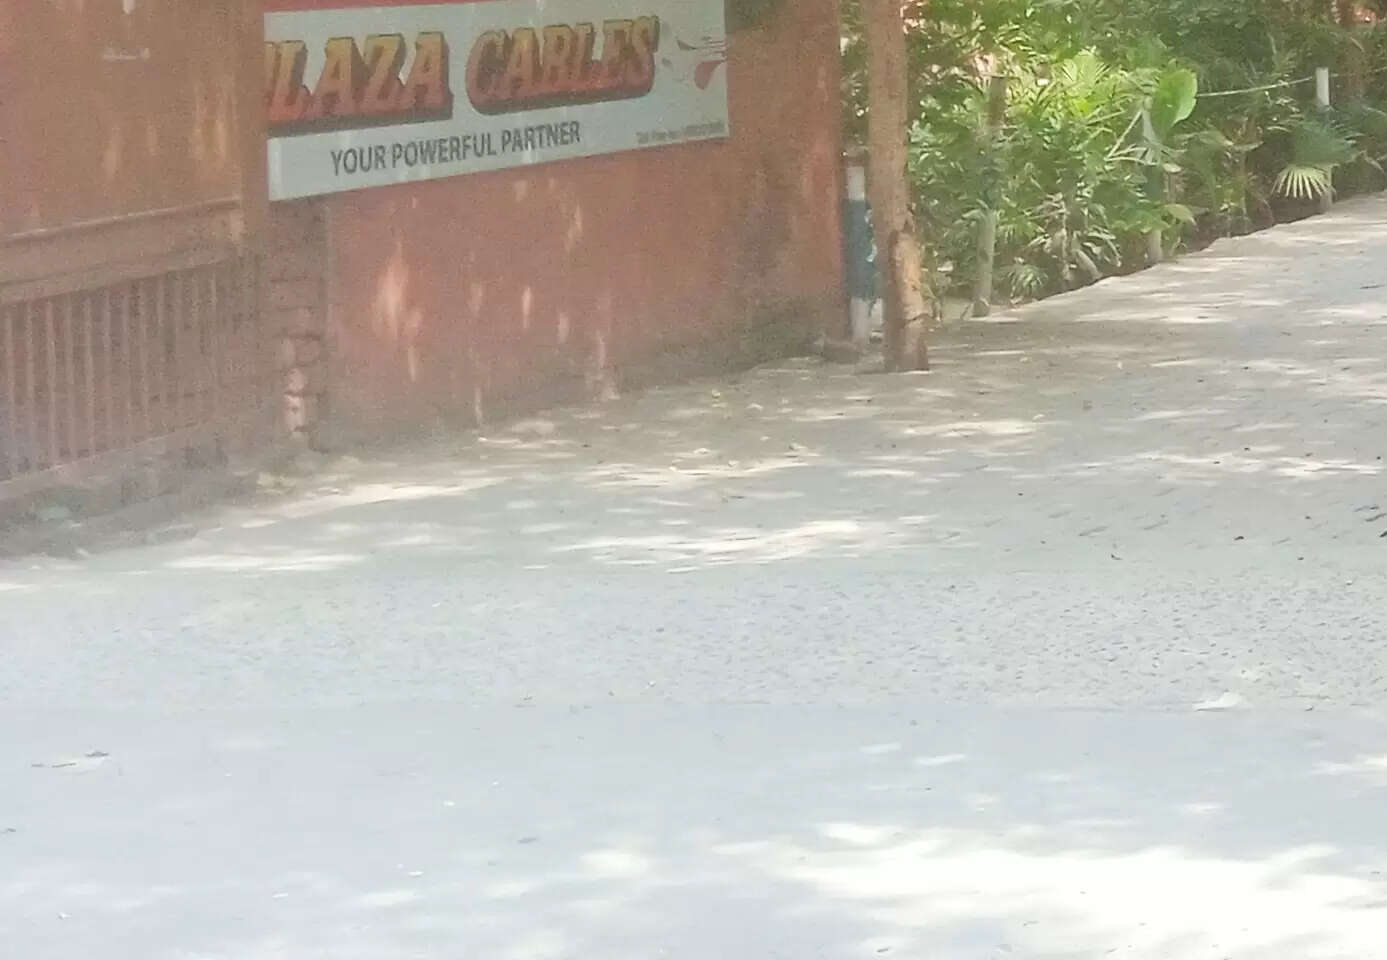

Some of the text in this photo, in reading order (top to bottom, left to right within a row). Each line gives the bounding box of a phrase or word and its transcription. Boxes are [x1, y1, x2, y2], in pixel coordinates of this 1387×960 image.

[466, 15, 660, 115] CABLES
[330, 121, 581, 176] YOUR POWERFUL PARTNER
